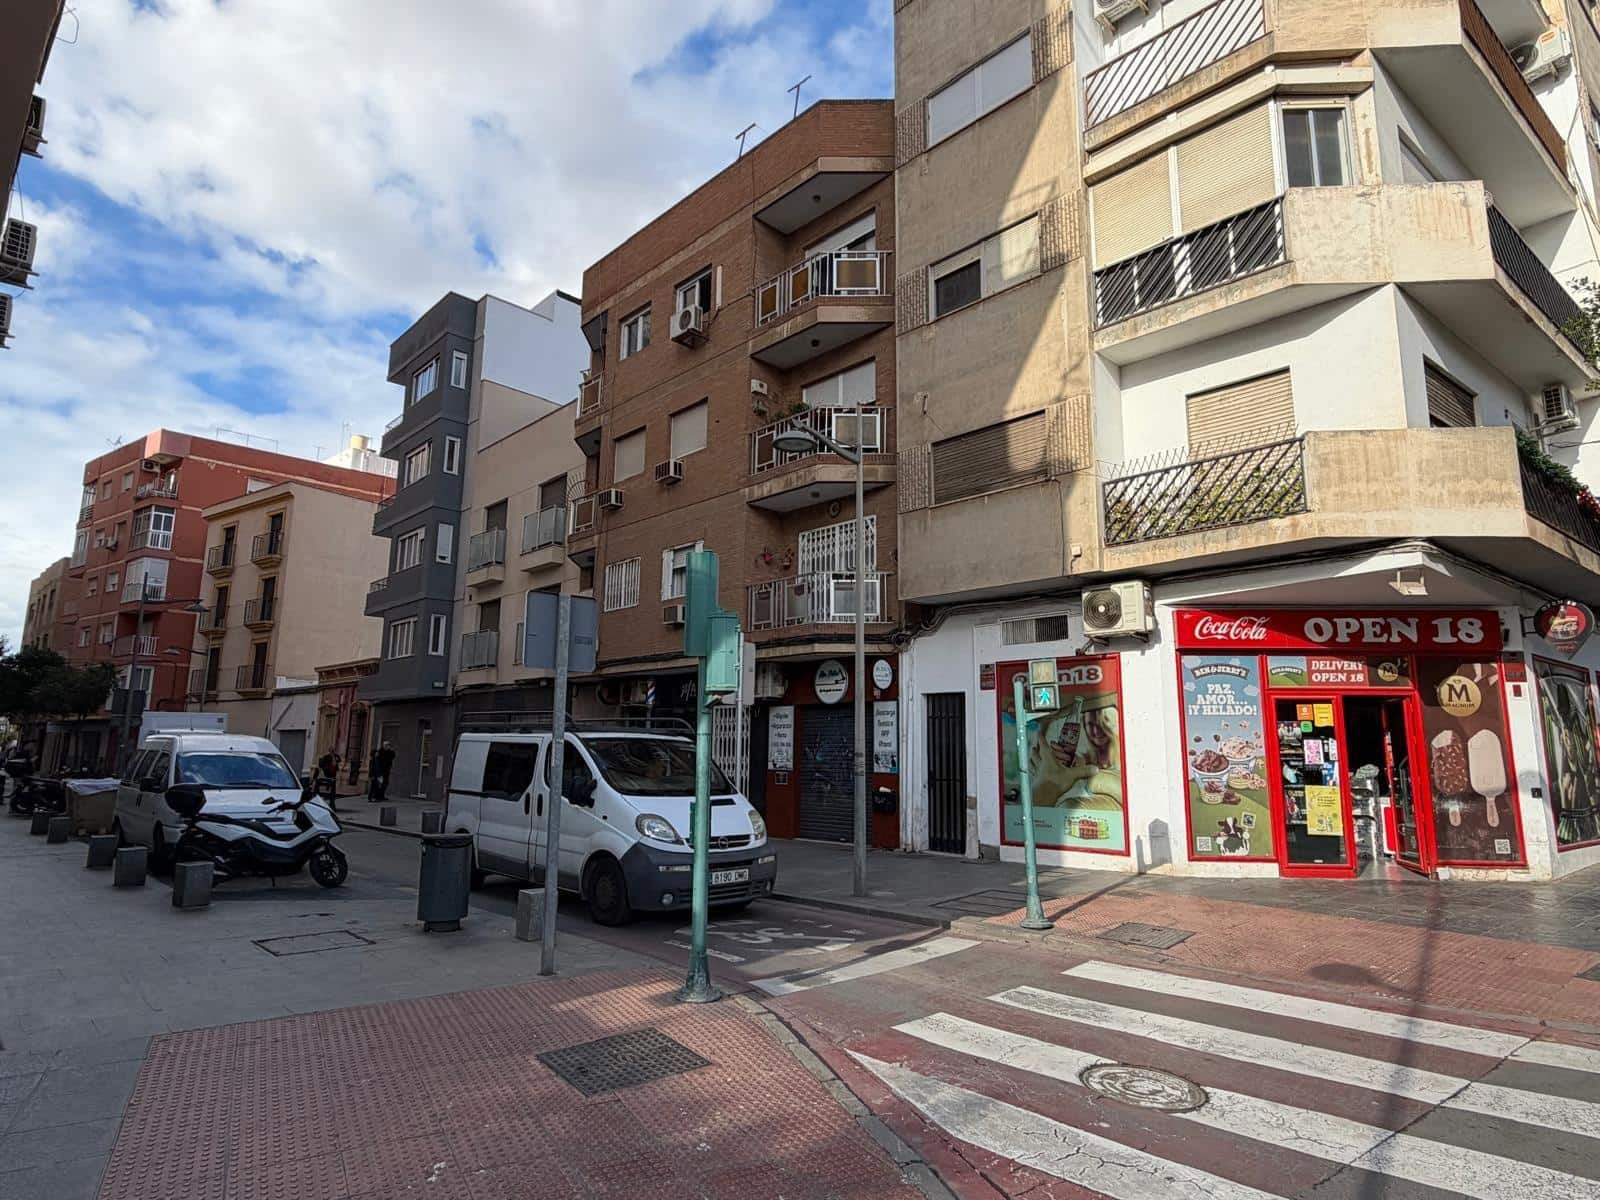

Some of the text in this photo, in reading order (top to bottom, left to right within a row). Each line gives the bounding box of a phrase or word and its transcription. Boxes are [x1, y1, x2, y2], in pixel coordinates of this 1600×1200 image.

[1195, 616, 1270, 640] Coca-Cola
[1303, 617, 1484, 644] OPEN 18
[1311, 661, 1365, 670] DELIVERY
[1312, 672, 1364, 682] OPEN 18
[1207, 684, 1236, 695] PAZ,
[1196, 694, 1248, 705] AMOR...
[1203, 705, 1257, 716] HELADO!
